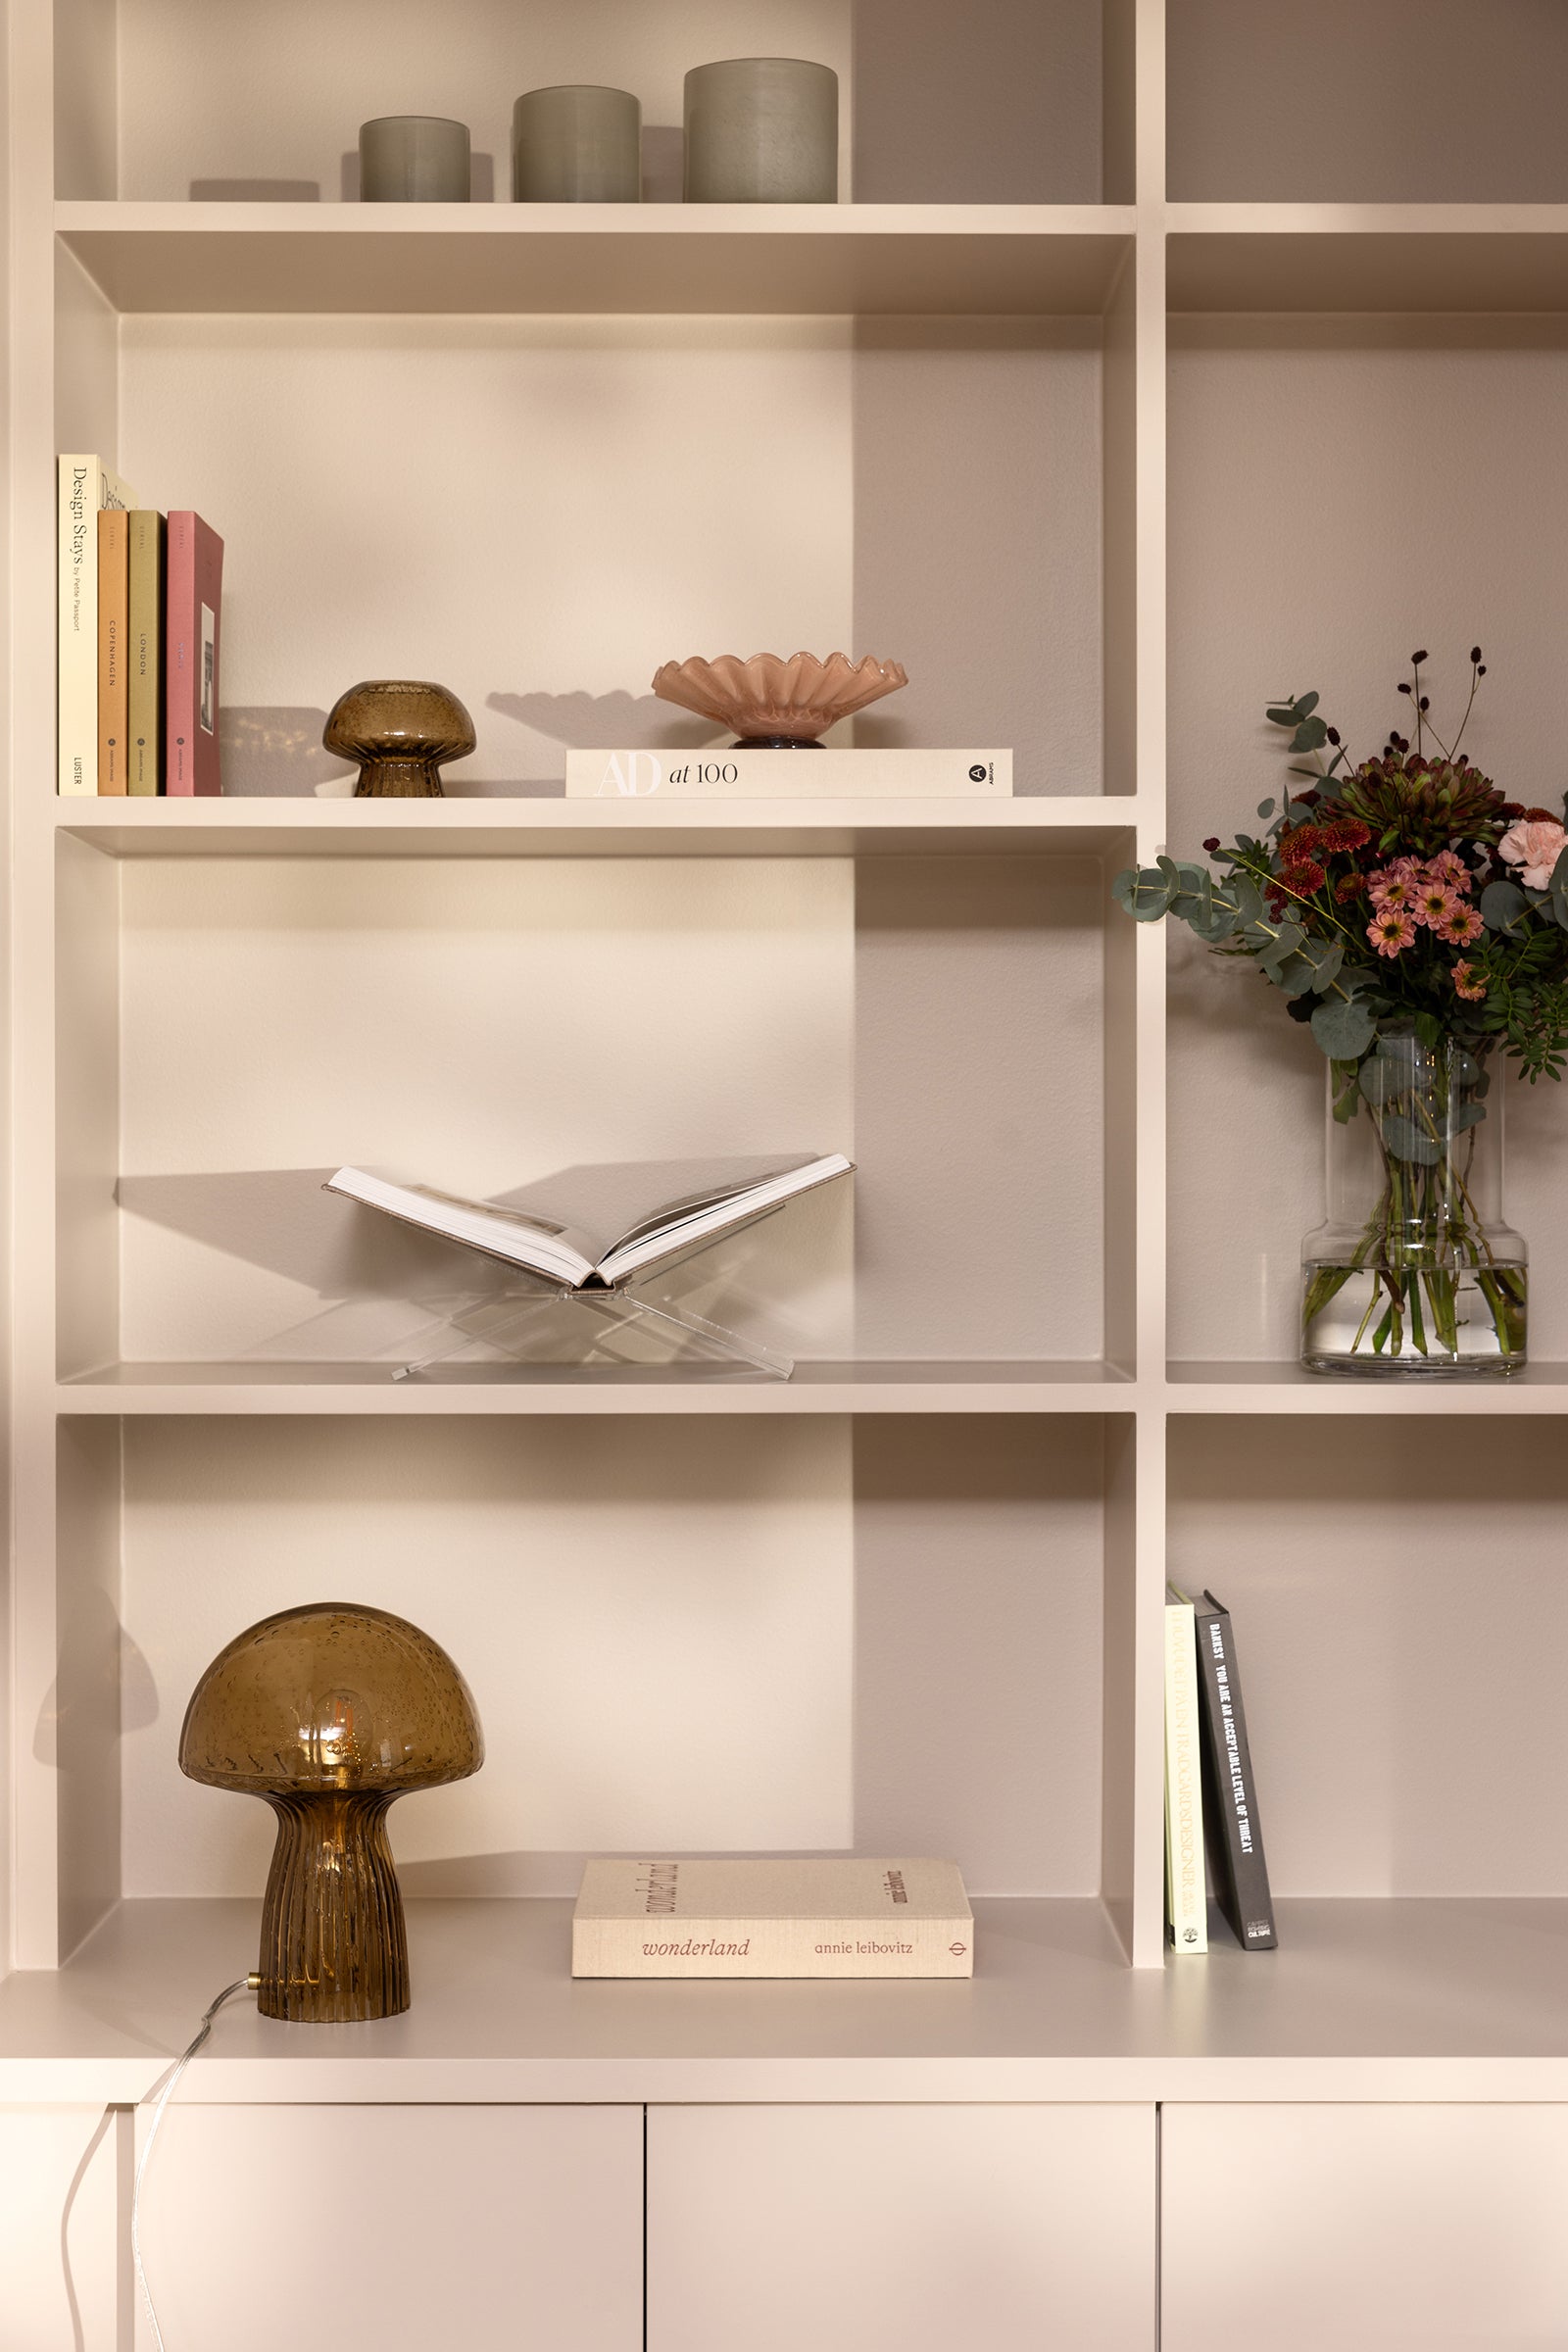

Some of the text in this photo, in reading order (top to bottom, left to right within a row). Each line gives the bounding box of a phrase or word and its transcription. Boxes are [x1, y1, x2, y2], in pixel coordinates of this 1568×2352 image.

[70, 467, 87, 519] Design
[69, 524, 87, 564] Stays
[74, 566, 80, 576] by
[72, 599, 81, 631] Passport
[74, 757, 82, 785] LUSTER
[593, 752, 738, 797] AD at 100
[1209, 1623, 1225, 1659] BANKSY
[1216, 1664, 1253, 1854] YOU ARE AN ACCEPTABLE LEVEL OF THREAT
[642, 1938, 751, 1956] wonderland
[814, 1941, 913, 1954] annie leibovitz
